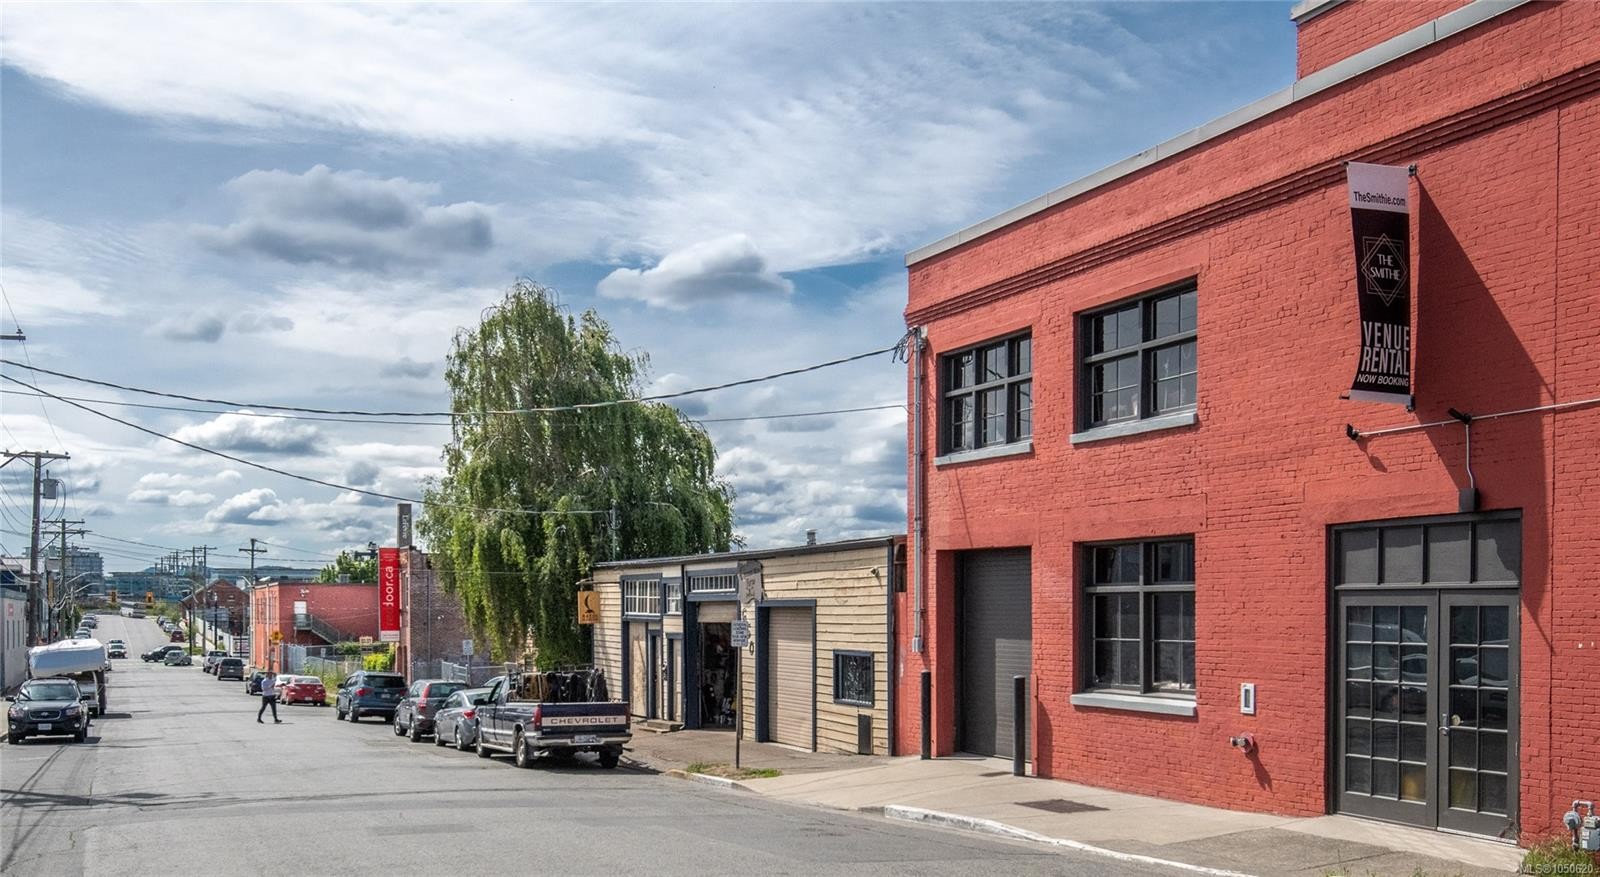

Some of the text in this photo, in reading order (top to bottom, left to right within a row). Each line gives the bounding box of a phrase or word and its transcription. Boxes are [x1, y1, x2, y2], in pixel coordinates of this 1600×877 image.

[1353, 191, 1406, 206] TheSmithie.com
[1377, 253, 1394, 267] THE
[1363, 320, 1409, 351] VENUE
[1361, 347, 1409, 376] RENTAL
[1357, 373, 1409, 387] NOW BOOKING
